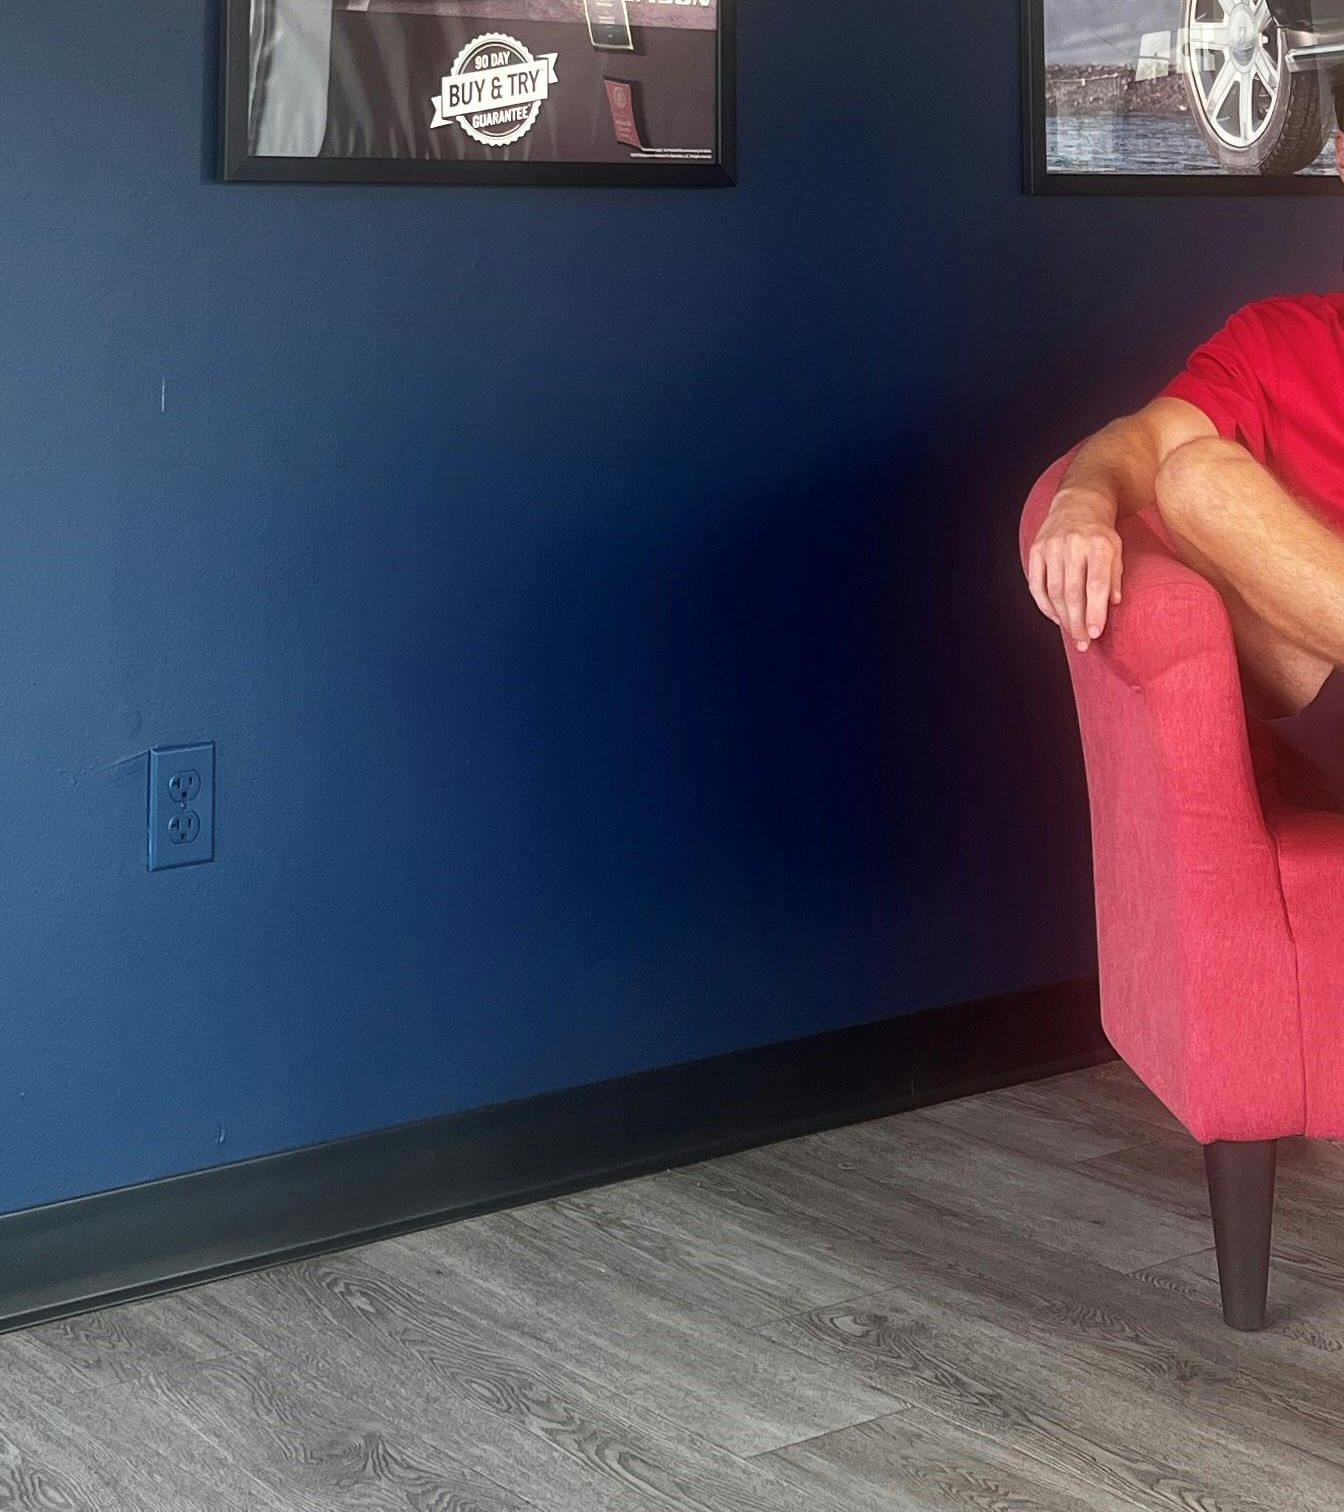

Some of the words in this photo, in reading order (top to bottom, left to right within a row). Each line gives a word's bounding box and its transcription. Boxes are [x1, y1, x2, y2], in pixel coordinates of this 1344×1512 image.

[474, 54, 488, 70] 90
[490, 50, 511, 67] DAY
[449, 78, 486, 108] BUY
[490, 76, 503, 100] &
[508, 69, 540, 96] TRY
[471, 106, 529, 129] GUARANTEE
